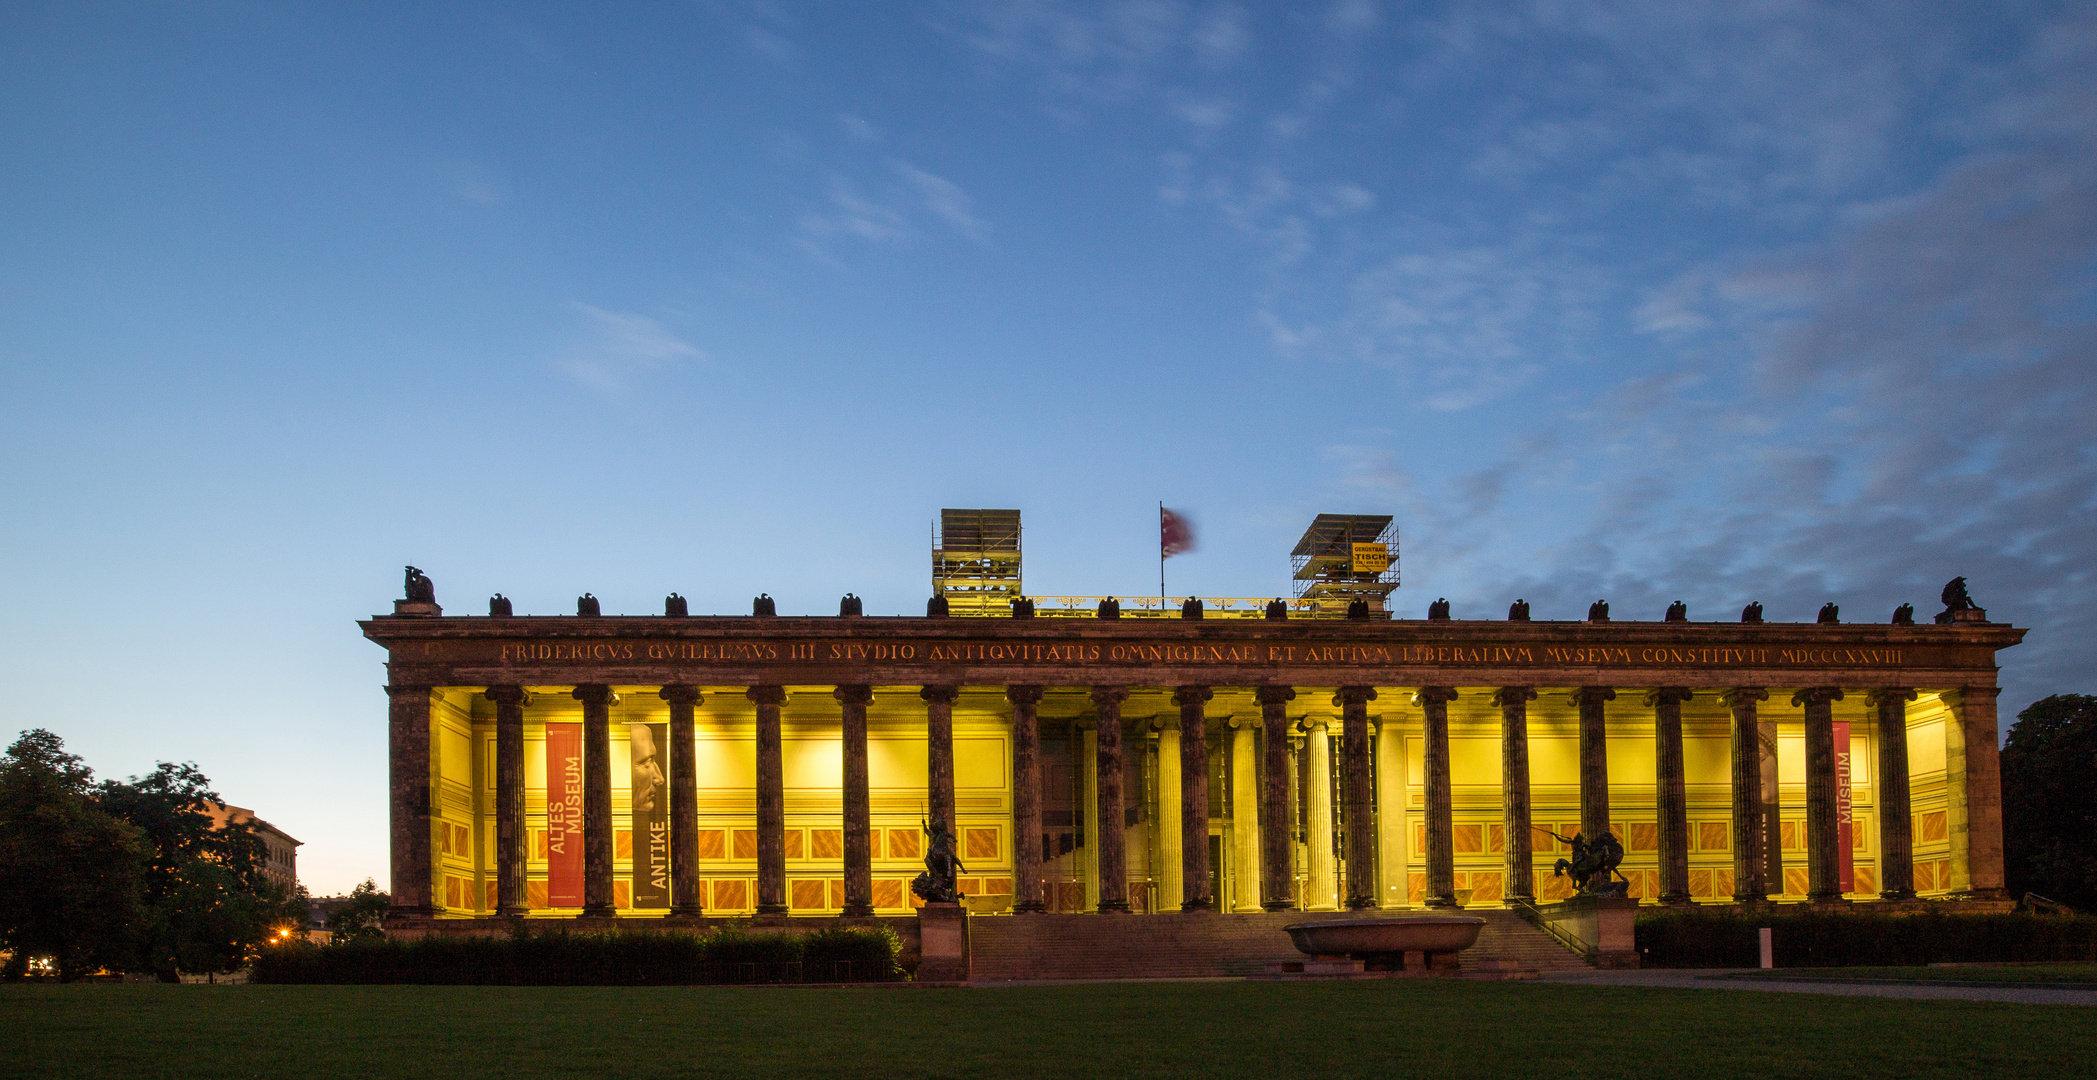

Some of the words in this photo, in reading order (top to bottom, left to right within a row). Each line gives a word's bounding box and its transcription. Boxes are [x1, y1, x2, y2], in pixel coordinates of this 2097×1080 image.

[502, 644, 634, 660] FRIDERICVS
[648, 644, 777, 660] GVILELMVS
[790, 644, 816, 660] III
[829, 644, 915, 660] STVDIO
[930, 645, 1100, 661] ANTIQVITATIS
[1112, 645, 1257, 661] OMNIGENAE
[1269, 646, 1296, 661] ET
[1305, 646, 1391, 662] ARTIVM
[1403, 646, 1533, 662] LIBERALIVM
[1544, 647, 1632, 663] MVSEVM
[1642, 648, 1769, 663] CONSTITVIT
[1779, 648, 1902, 664] MDCCCXXVIII
[565, 757, 581, 834] MUSEUM
[1837, 752, 1851, 824] MUSEUM
[549, 802, 565, 854] ALTES
[650, 821, 667, 889] ANTIKE
